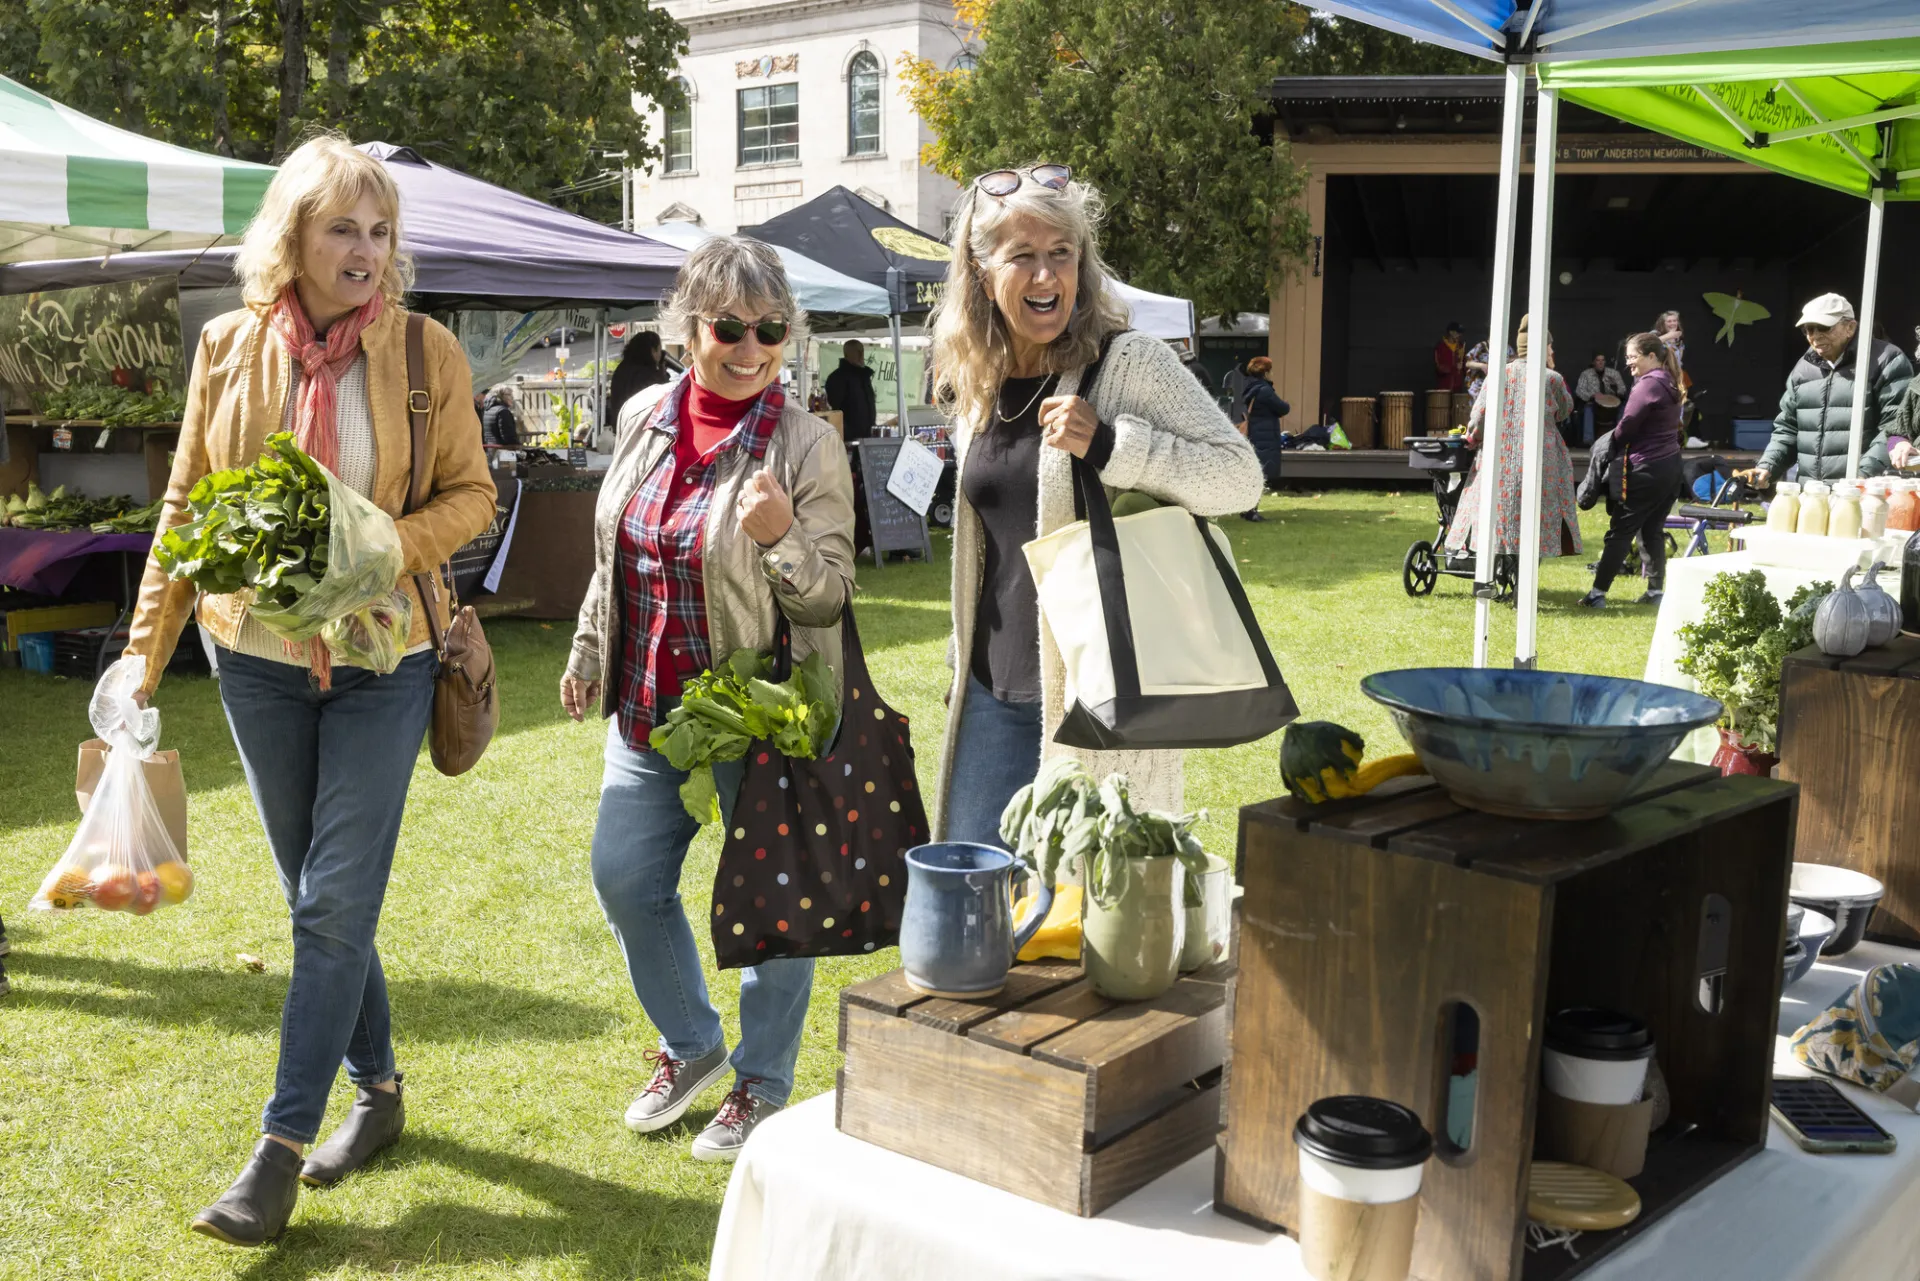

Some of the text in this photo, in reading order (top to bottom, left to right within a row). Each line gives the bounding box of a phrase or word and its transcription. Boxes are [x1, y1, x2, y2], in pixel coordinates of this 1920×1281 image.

[1603, 149, 1650, 159] ANDERSON
[1654, 148, 1698, 158] MEMORIAL
[565, 308, 591, 328] Wine
[93, 322, 167, 371] CROW
